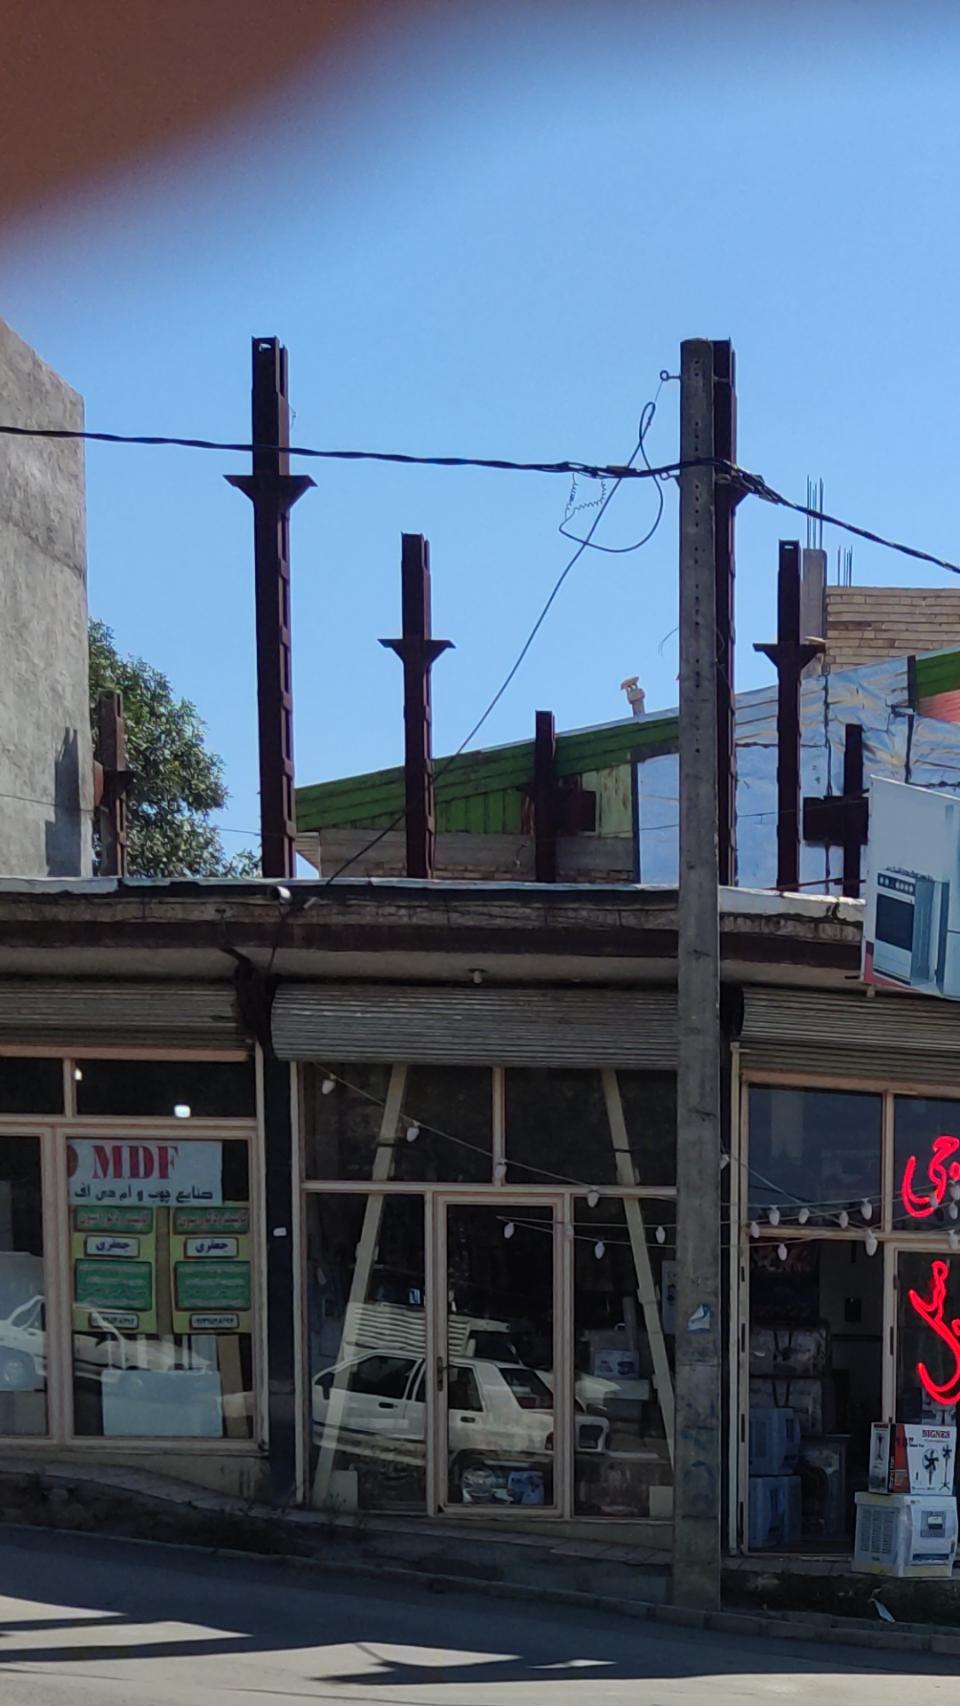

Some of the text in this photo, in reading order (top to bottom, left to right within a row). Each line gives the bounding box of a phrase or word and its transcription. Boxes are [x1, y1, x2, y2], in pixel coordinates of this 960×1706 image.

[92, 1145, 178, 1179] MDF
[74, 1182, 91, 1198] اف
[96, 1189, 116, 1201] دی
[119, 1184, 132, 1201] ام
[137, 1189, 144, 1201] و
